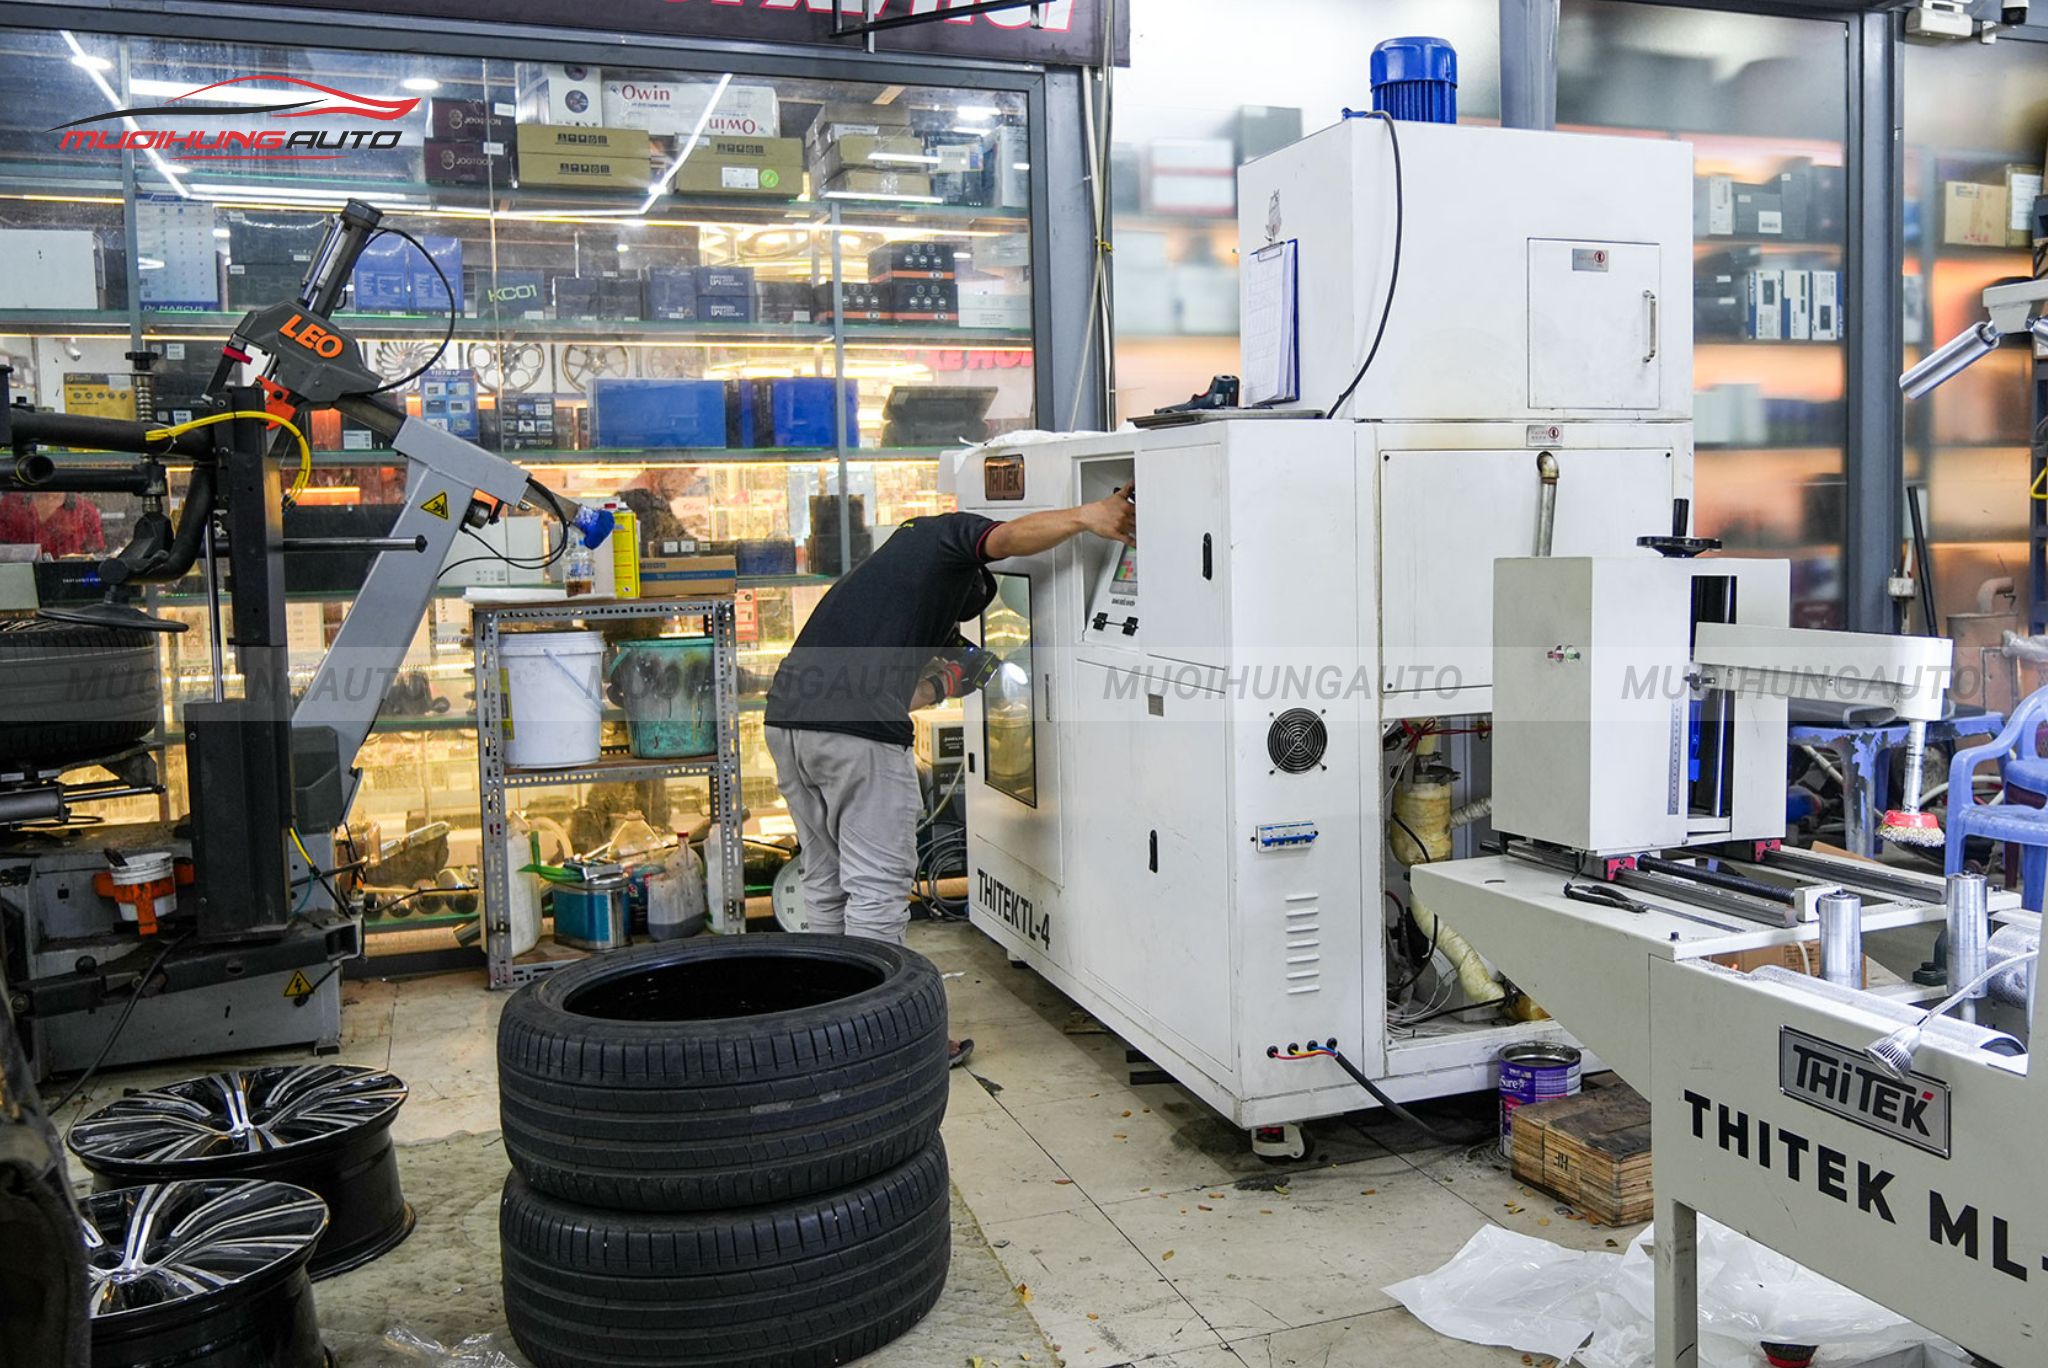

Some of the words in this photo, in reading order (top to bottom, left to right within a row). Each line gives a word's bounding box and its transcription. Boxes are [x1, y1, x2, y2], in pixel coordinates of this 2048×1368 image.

[621, 84, 671, 101] Owin
[279, 313, 344, 359] LEO
[1684, 1089, 1896, 1225] THITEK
